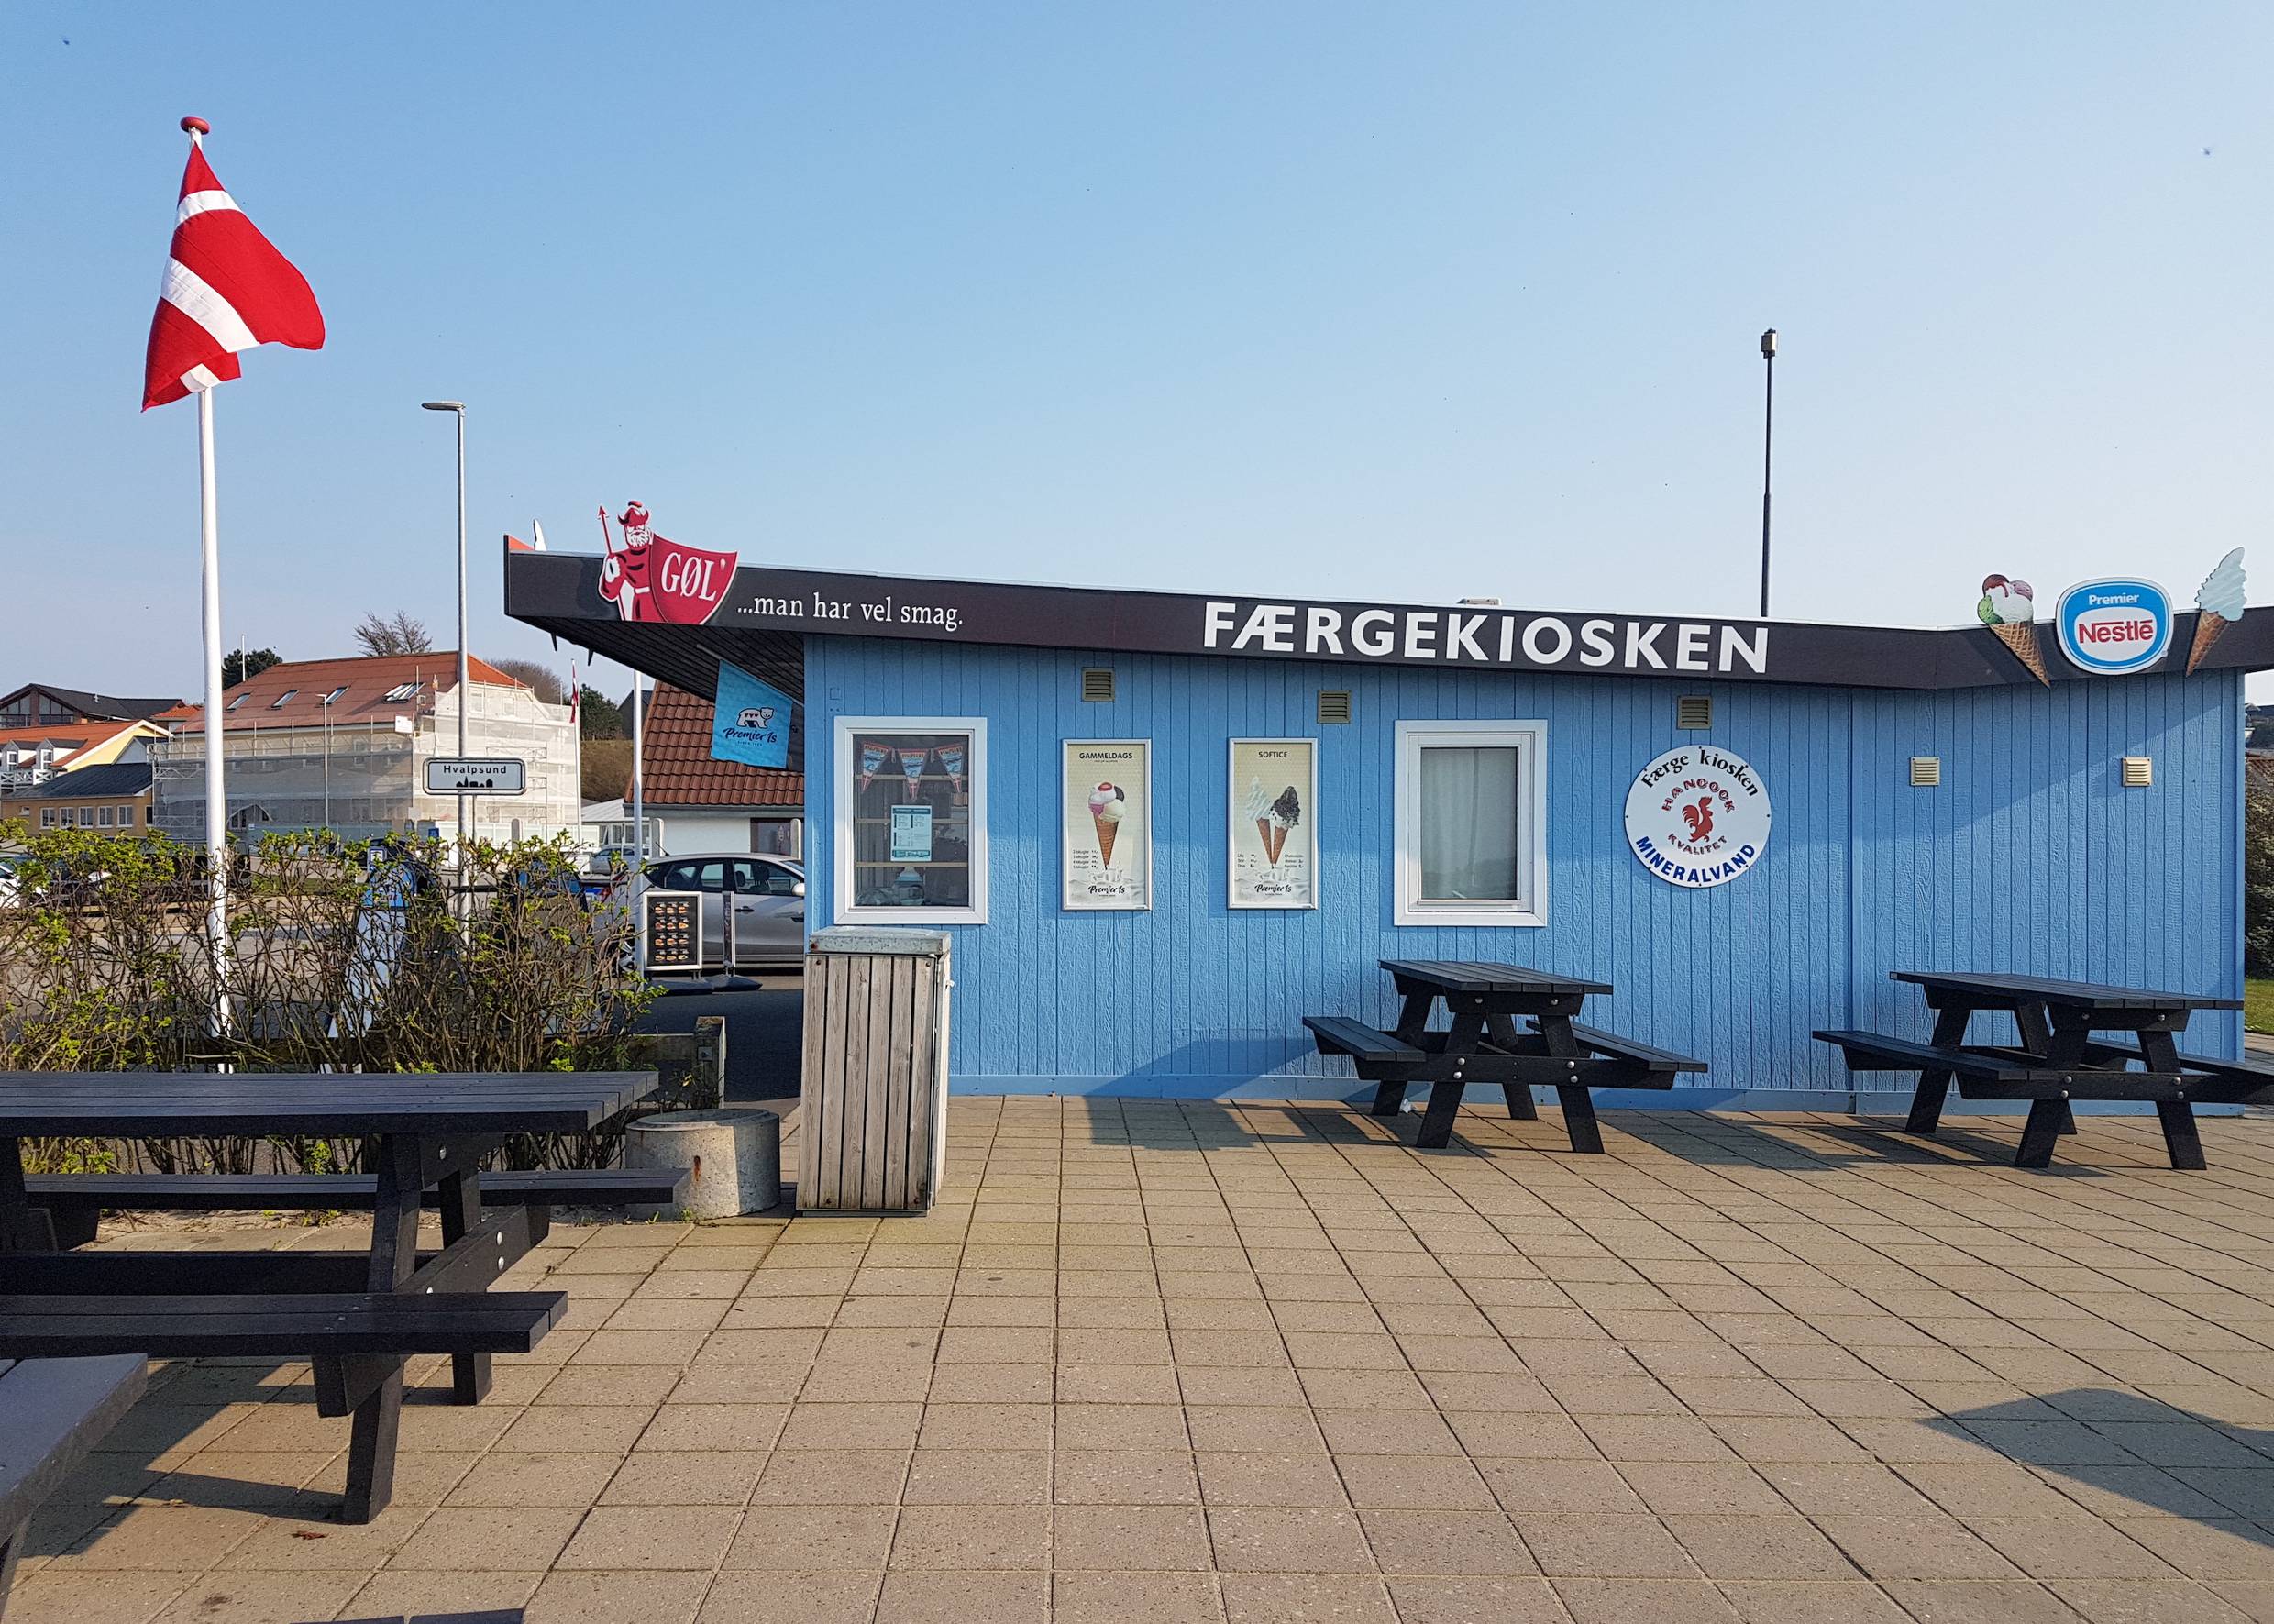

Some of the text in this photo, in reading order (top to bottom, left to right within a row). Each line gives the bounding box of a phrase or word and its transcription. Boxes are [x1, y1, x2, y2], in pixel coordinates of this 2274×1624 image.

[2089, 592, 2140, 605] Premier
[812, 591, 851, 620] har
[860, 596, 892, 623] vel
[900, 605, 963, 632] smag.
[1203, 601, 1770, 674] FÆRGEKIOSKEN
[2078, 619, 2154, 644] Nestlé
[723, 727, 766, 742] Premier
[443, 765, 507, 775] Hvalpsund
[1640, 749, 1758, 797] Færge kiosken
[1667, 833, 1728, 856] KVALITET
[1636, 835, 1755, 883] MINERALVAND
